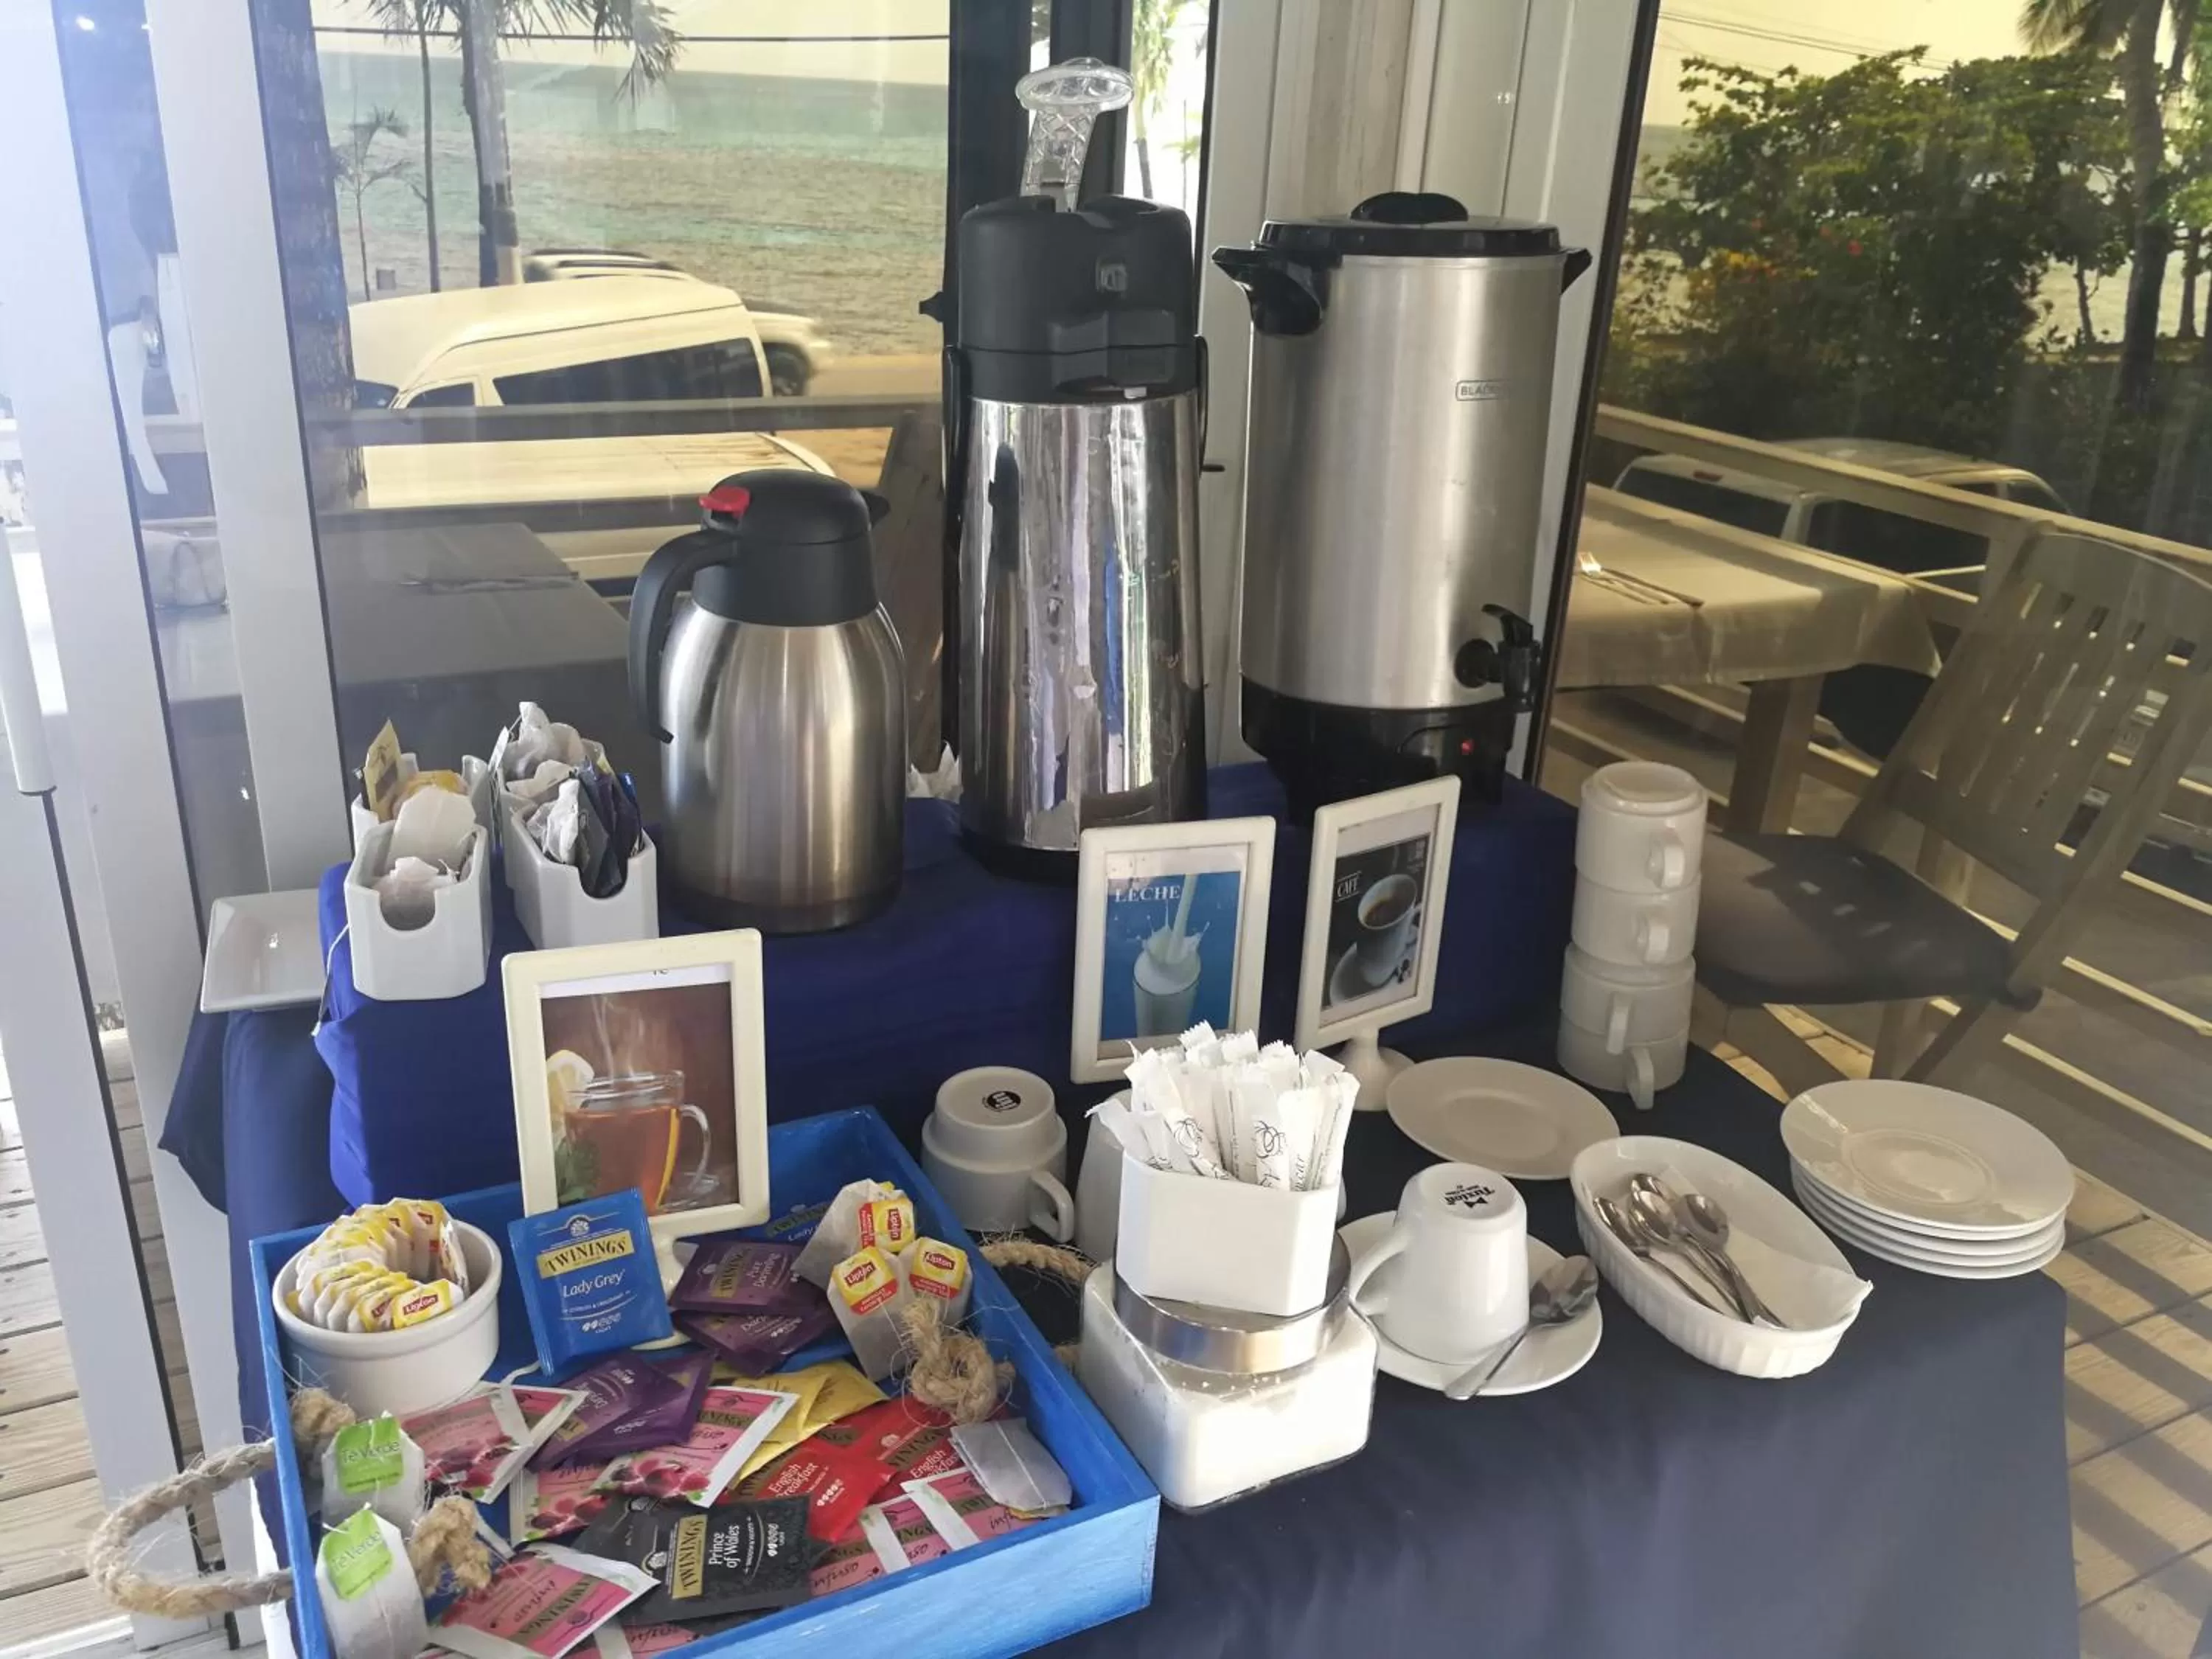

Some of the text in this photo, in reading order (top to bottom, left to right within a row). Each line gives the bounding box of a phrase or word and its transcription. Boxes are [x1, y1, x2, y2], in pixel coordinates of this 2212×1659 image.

[1115, 886, 1180, 902] LECHE
[890, 1210, 900, 1239] Lipton
[545, 1237, 627, 1273] TWININGS
[927, 1252, 954, 1270] Lipton
[563, 1269, 625, 1298] Lady Grey
[847, 1263, 874, 1284] Lipton
[768, 1463, 801, 1493] English
[911, 1449, 946, 1478] English
[678, 1520, 704, 1590] TWININGS
[709, 1531, 724, 1565] Prince
[724, 1525, 741, 1568] of Wales
